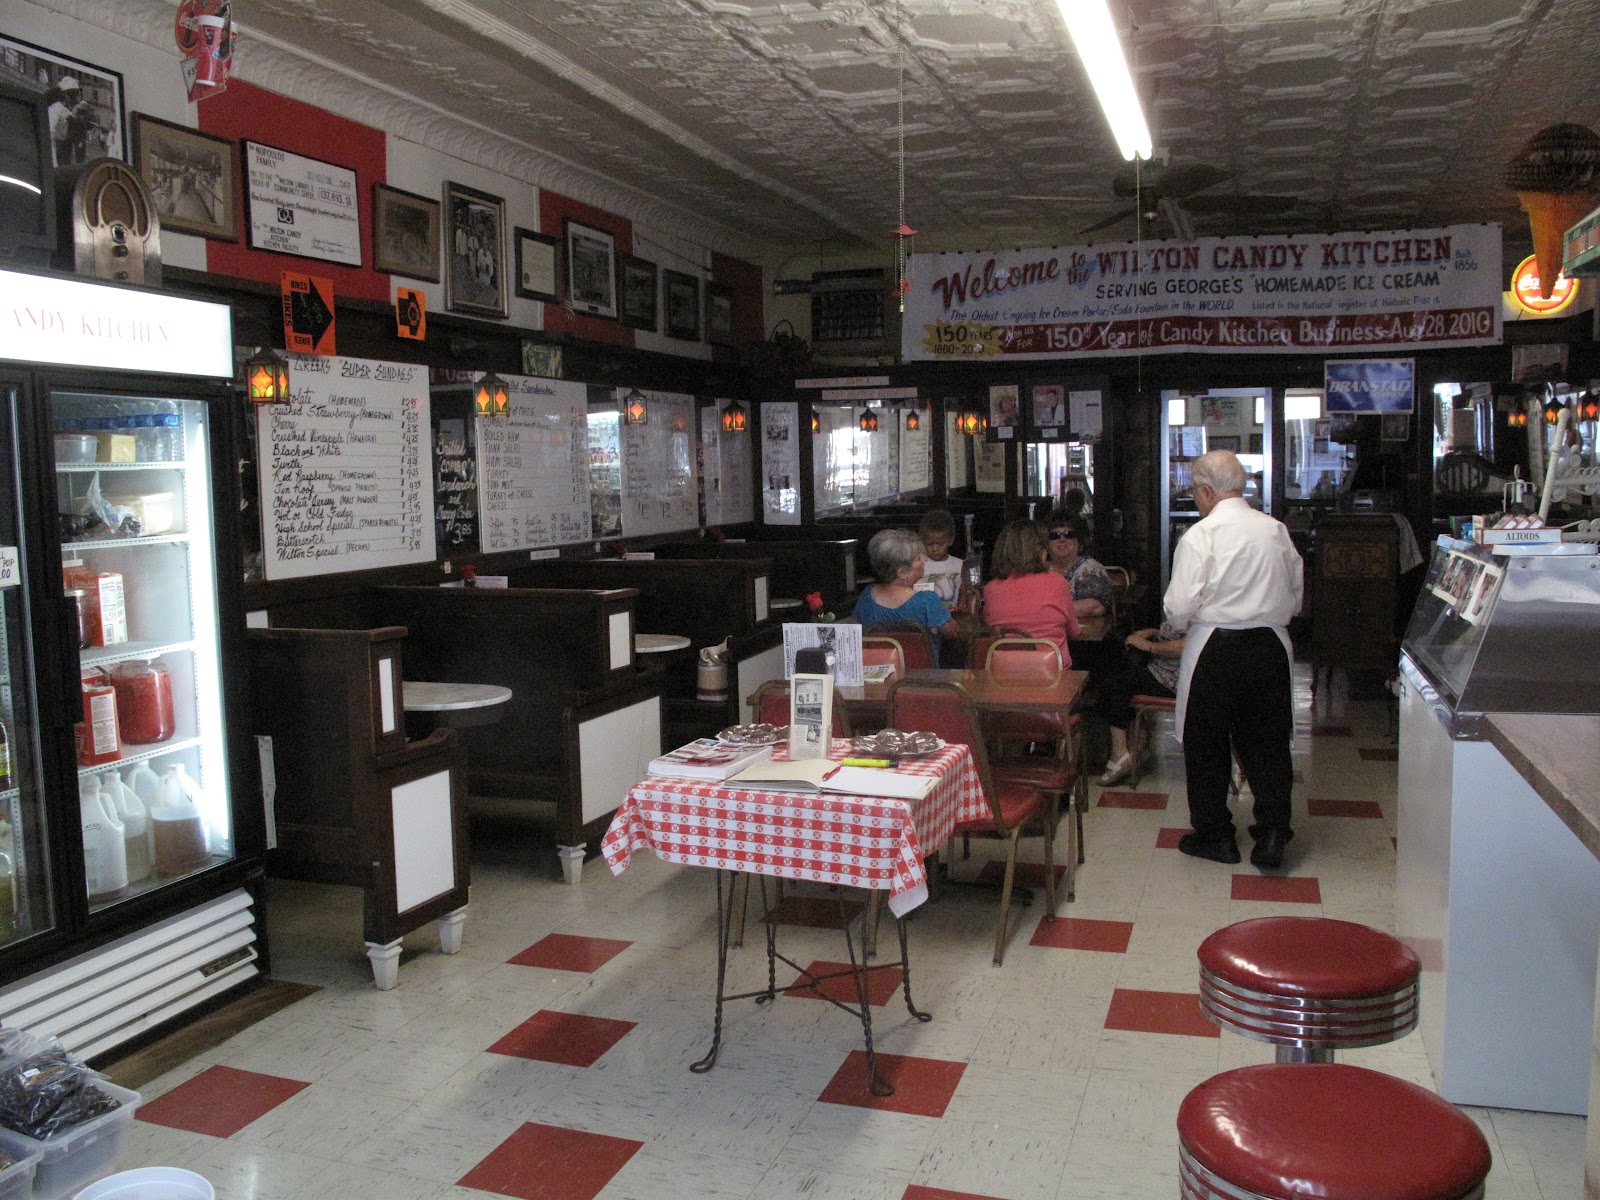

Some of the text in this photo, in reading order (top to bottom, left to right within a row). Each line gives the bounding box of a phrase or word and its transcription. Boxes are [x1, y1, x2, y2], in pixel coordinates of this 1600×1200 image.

[256, 156, 276, 168] FAMILY
[274, 184, 300, 197] COMMUNITY
[1097, 236, 1452, 273] WILTON CANDY KITCHEN
[1455, 260, 1477, 270] 1856
[931, 252, 1086, 309] Welcome to
[1067, 267, 1089, 285] the
[291, 280, 308, 290] BIKES
[1096, 281, 1157, 299] SERVING
[1166, 276, 1243, 294] GEORGE'S
[1353, 275, 1375, 290] ICE
[284, 294, 293, 327] BIKES
[951, 310, 967, 321] The
[971, 310, 998, 321] Oldest
[1040, 307, 1051, 319] Ice
[1053, 307, 1079, 318] Cream
[1171, 301, 1180, 310] in
[1183, 301, 1195, 310] the
[1253, 301, 1275, 310] Listed
[1288, 301, 1300, 309] the
[936, 325, 993, 342] 150 YEARS
[1098, 325, 1136, 348] Year
[1140, 325, 1154, 343] of
[1160, 320, 1213, 345] Candy
[1219, 320, 1292, 344] Kitchen
[1016, 338, 1032, 349] FOR
[294, 355, 331, 374] GREEKS
[1328, 380, 1411, 393] BRANSTAD
[268, 404, 303, 416] Crushed
[307, 404, 359, 429] Strawberry
[271, 416, 298, 430] Cherry
[483, 416, 504, 427] COMBO
[271, 430, 306, 442] Crushed
[310, 428, 344, 445] Pineapple
[484, 429, 520, 441] BOILED HAM
[272, 444, 301, 456] Black
[316, 444, 342, 457] White
[484, 442, 521, 454] TUNA SALAD
[272, 457, 303, 470] Turtle
[486, 456, 522, 468] HAM SALAD
[272, 470, 292, 482] Red
[296, 470, 336, 486] Raspberry
[339, 470, 377, 482] (HOMEGROWN)
[486, 469, 509, 479] TURKEY
[487, 480, 514, 489] TUNA MELT
[274, 484, 291, 495] Tin
[293, 483, 314, 500] Roof
[487, 490, 533, 501] TURKEY CHEESE
[273, 496, 308, 509] Chocolate
[311, 495, 335, 510] Jersey
[487, 501, 508, 511] CHEESE
[274, 510, 291, 522] Hot
[293, 511, 301, 521] or
[306, 507, 325, 519] Cold
[327, 506, 353, 524] Fudge
[275, 523, 295, 537] High
[299, 519, 324, 532] School
[326, 520, 355, 535] Special
[277, 535, 325, 548] Butterscotch
[1505, 532, 1540, 541] ALTOIDS
[277, 547, 305, 561] Wilton
[306, 545, 340, 563] Special
[3, 558, 14, 567] POP
